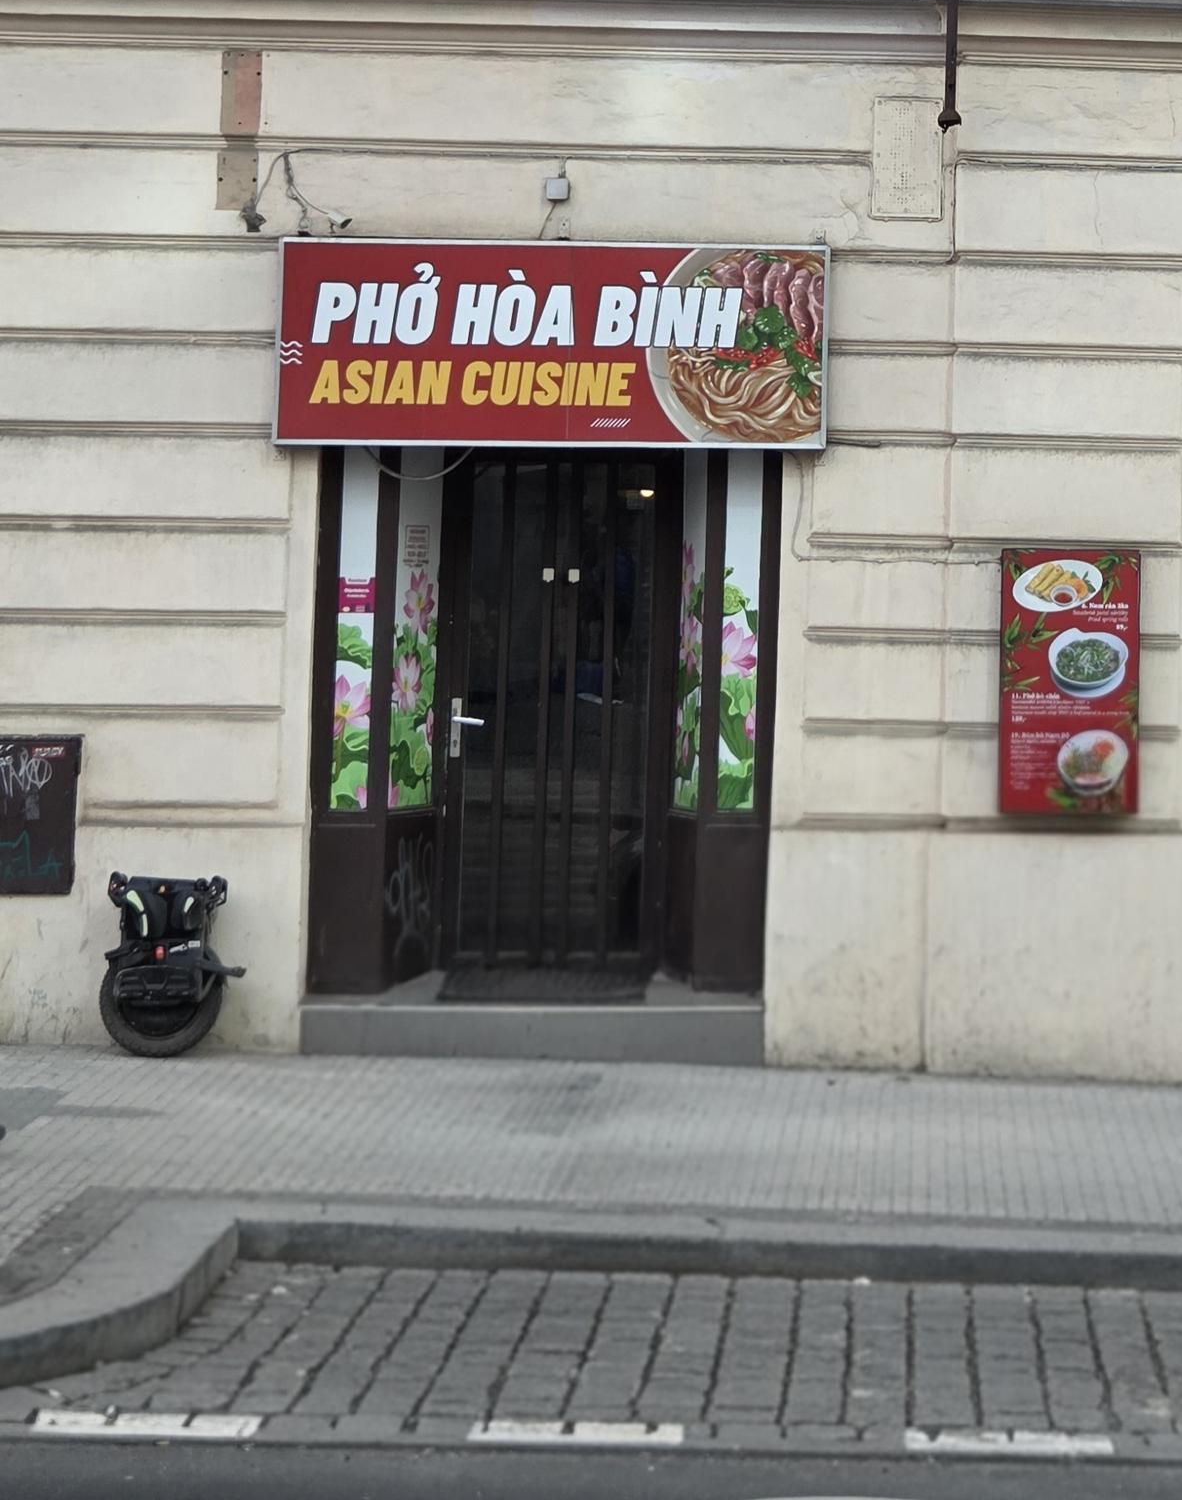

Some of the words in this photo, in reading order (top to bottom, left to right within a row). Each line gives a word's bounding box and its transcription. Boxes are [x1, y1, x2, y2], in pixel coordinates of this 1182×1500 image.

[311, 262, 442, 346] PHỞ
[451, 269, 575, 347] HÒA
[593, 271, 743, 349] BÌNH
[309, 359, 450, 406] ASIAN
[460, 360, 637, 407] CUISINE
